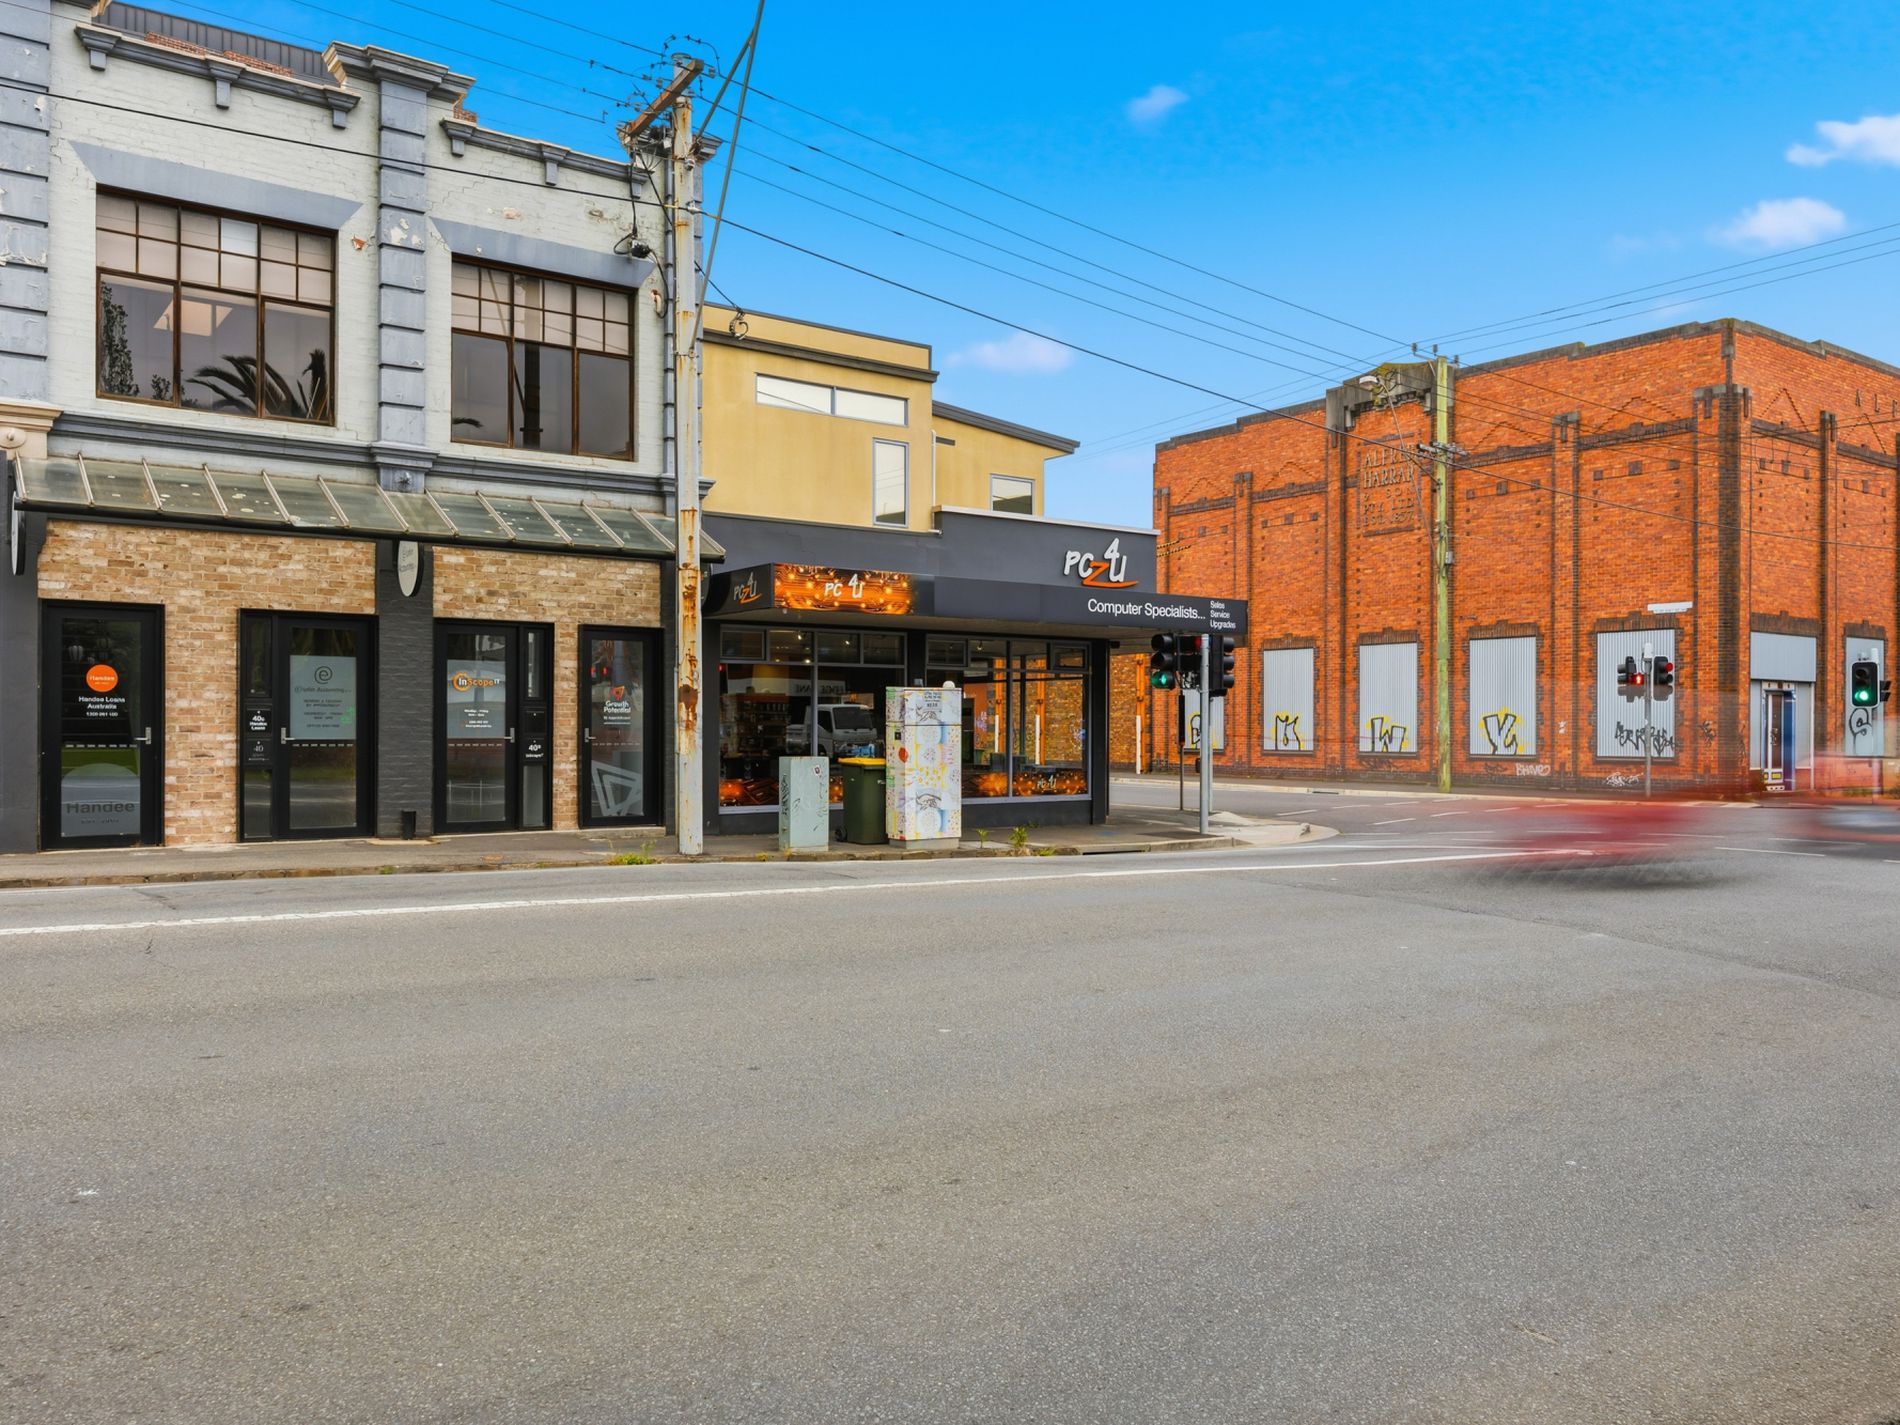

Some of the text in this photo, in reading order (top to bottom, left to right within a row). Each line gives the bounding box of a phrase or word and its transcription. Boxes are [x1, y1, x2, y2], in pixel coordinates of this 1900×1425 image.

[1087, 598, 1143, 617] Computer
[1209, 600, 1225, 609] Sales
[1209, 609, 1230, 619] Service
[1209, 619, 1237, 630] Upgrades
[66, 801, 136, 814] Handee
